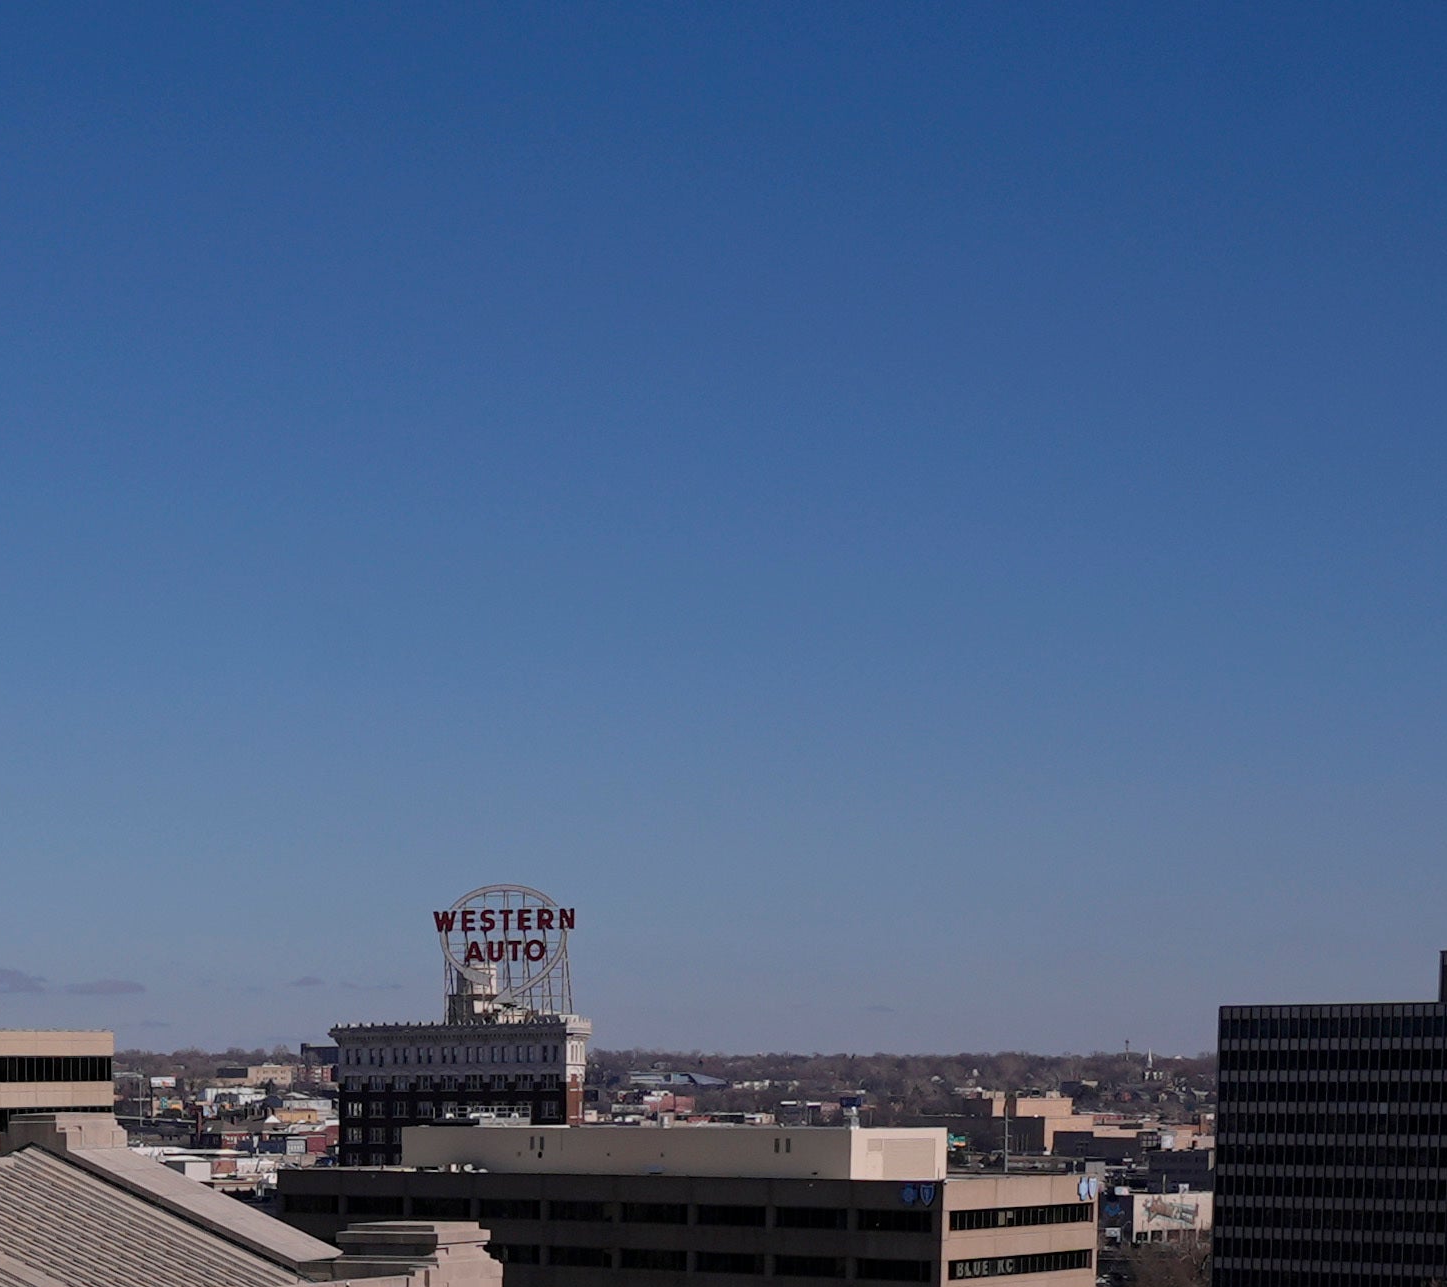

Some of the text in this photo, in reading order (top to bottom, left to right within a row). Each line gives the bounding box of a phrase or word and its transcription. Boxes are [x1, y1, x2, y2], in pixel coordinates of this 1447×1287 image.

[433, 908, 575, 933] WESTERN
[464, 938, 546, 962] AUTO
[956, 1258, 1014, 1278] BLUE KC
